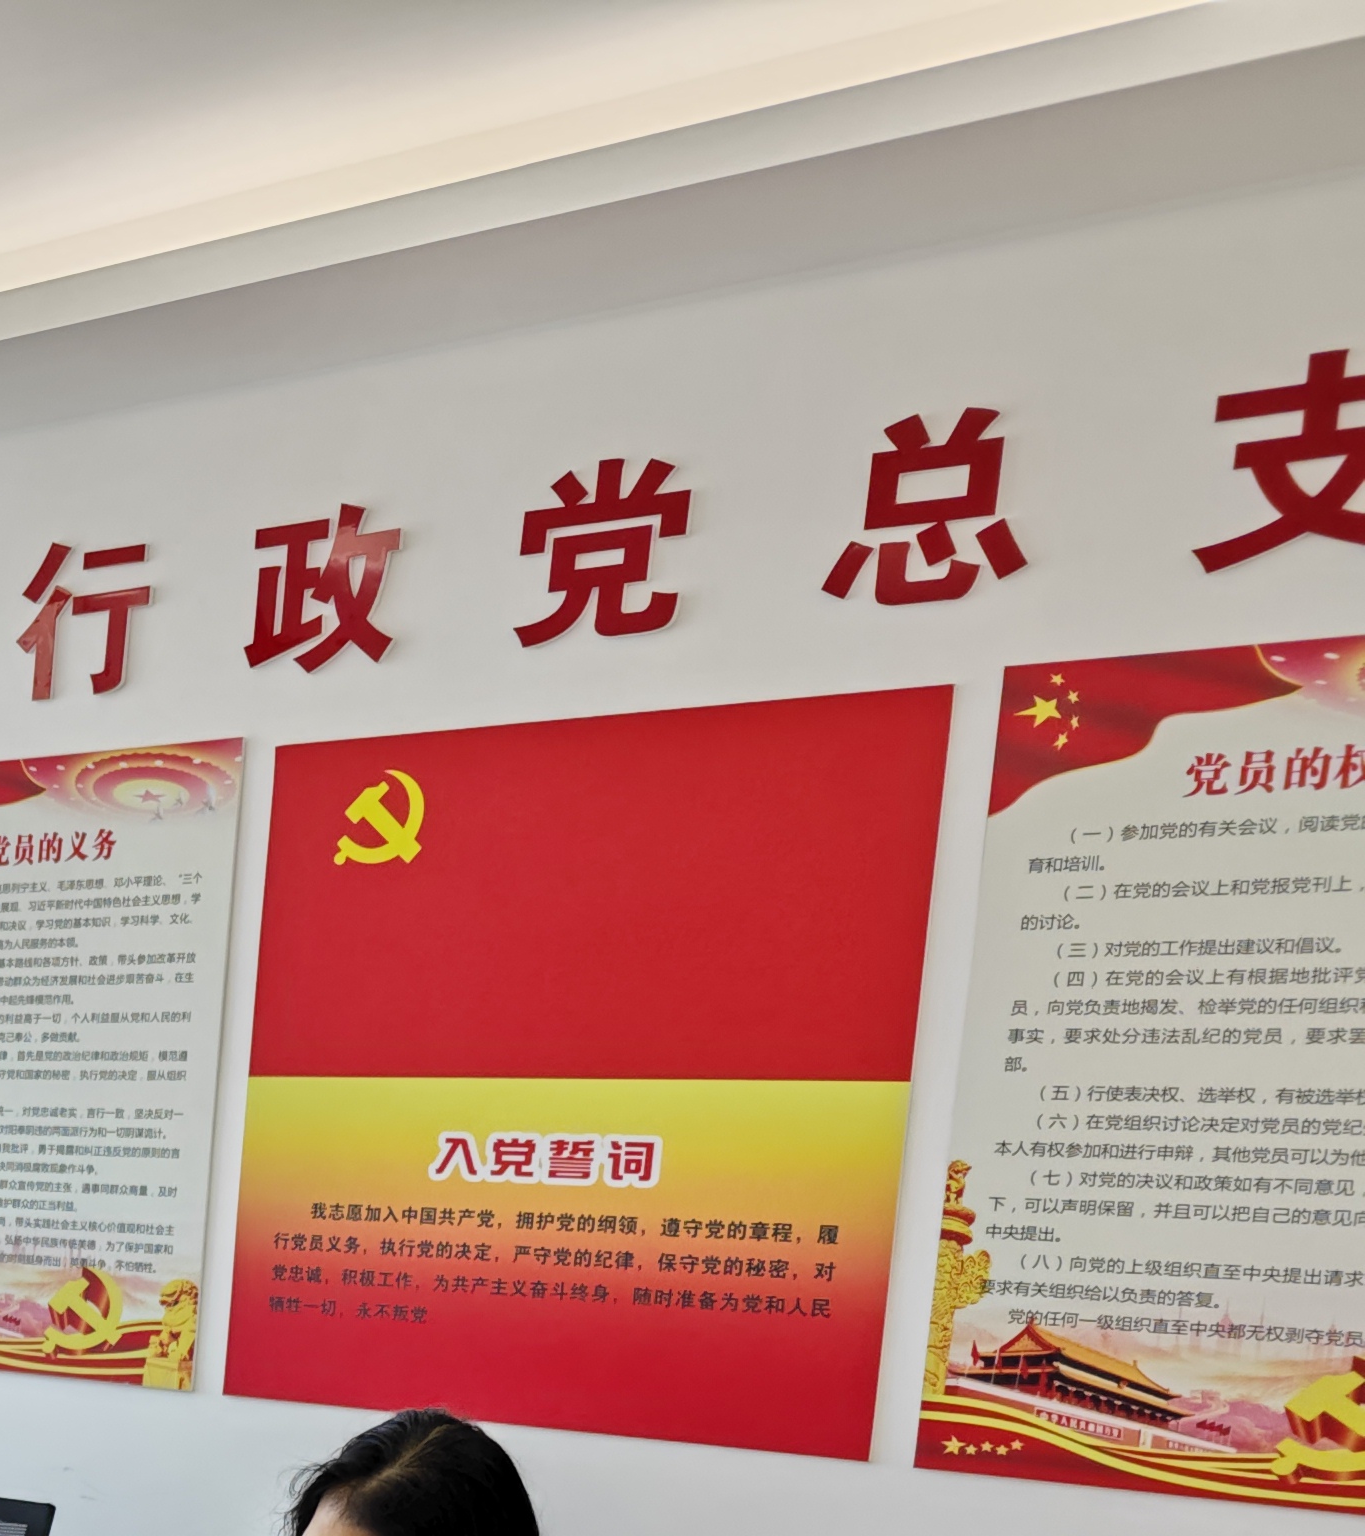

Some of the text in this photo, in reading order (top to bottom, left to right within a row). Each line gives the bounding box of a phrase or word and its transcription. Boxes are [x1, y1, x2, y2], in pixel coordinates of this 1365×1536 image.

[16, 349, 1365, 700] 行政党总支
[1183, 744, 1365, 797] 党员的权
[1070, 811, 1365, 844] （一）参加党的有关会议，阅读党
[1028, 854, 1104, 874] 育和培训。
[1063, 873, 1365, 902] （二）在党的会议上和党报党刊上，
[1020, 913, 1079, 930] 的讨论。
[1056, 936, 1341, 959] （三）对党的工作提出建议和倡议。
[1009, 995, 1365, 1019] 员，向党负责地揭发、检举党的任何组织
[1003, 1055, 1027, 1072] 部。
[1036, 1112, 1365, 1140] （六）在党组织讨论决定对党员的党纪
[435, 1138, 656, 1181] 入党誓词
[310, 1201, 839, 1245] 我志愿加入中国共产党，拥护党的纲领，遵守党的章程，履
[985, 1223, 1060, 1242] 中央提出。
[273, 1231, 836, 1282] 行党员义务，执行党的决定，严守党的纪律，保守党的秘密，对
